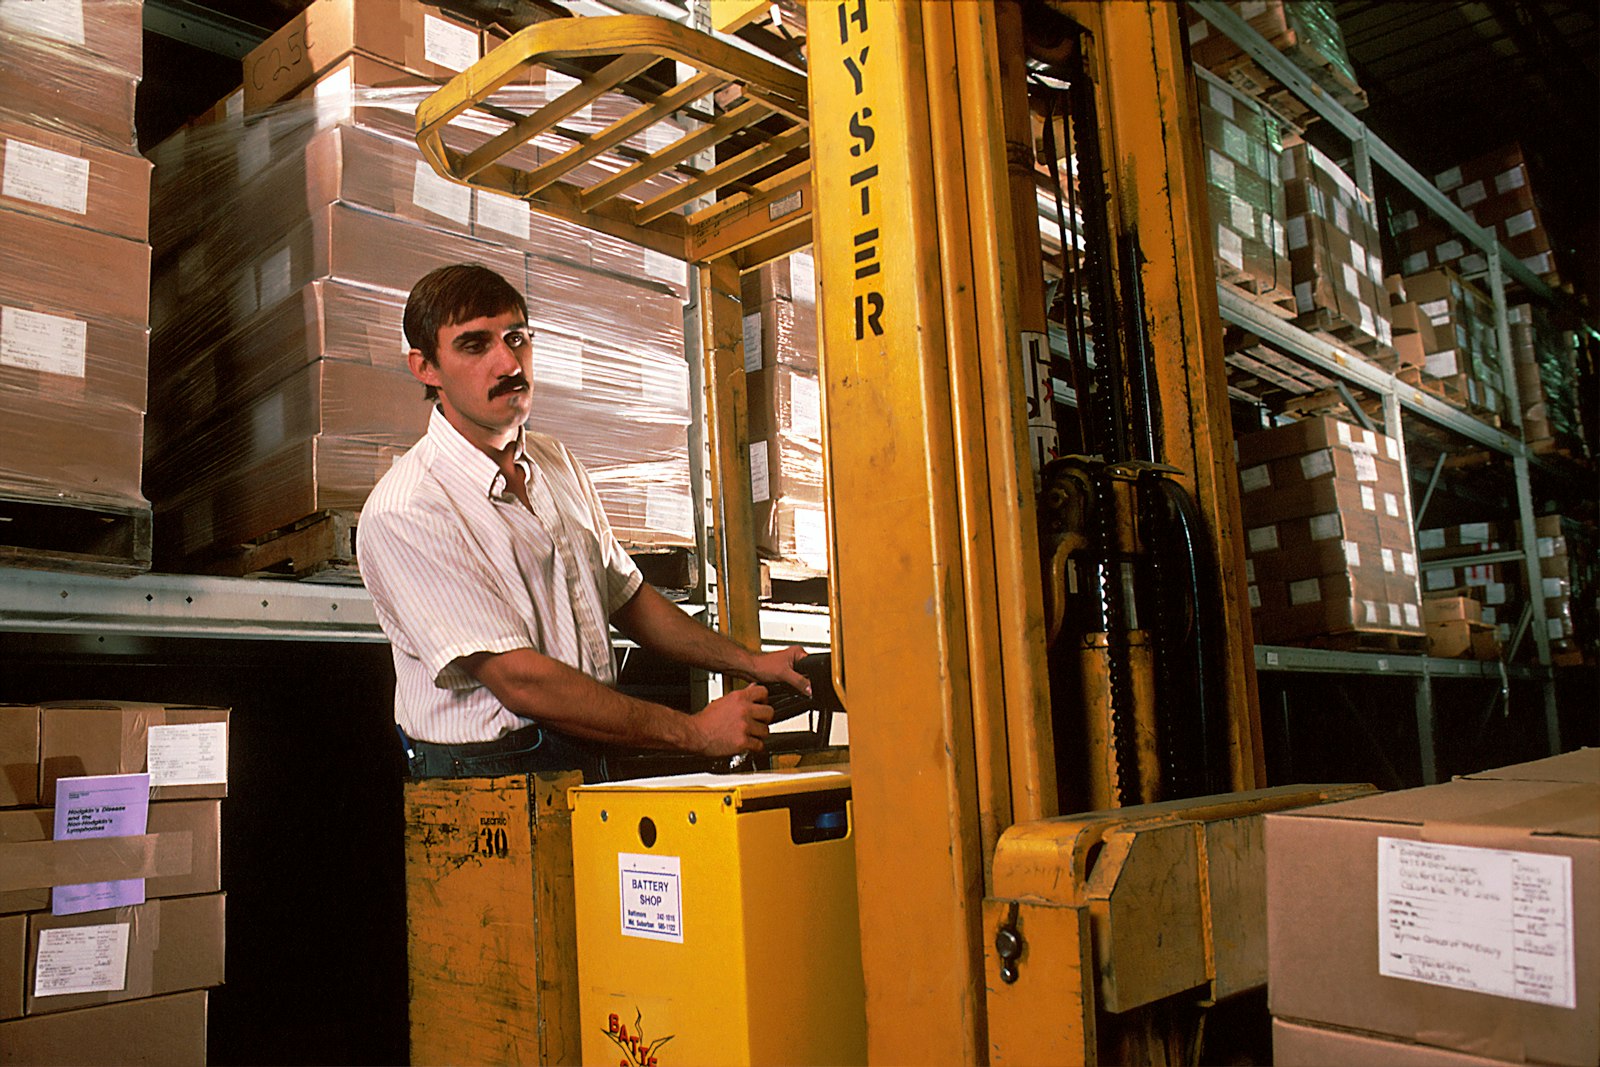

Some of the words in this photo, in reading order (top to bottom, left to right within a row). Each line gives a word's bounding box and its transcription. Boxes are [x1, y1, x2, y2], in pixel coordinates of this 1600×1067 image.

[838, 0, 885, 340] HYSTER
[632, 879, 669, 893] BATTERY
[640, 894, 662, 907] SHOP
[628, 909, 647, 919] Baltimore
[637, 919, 655, 928] Suburban
